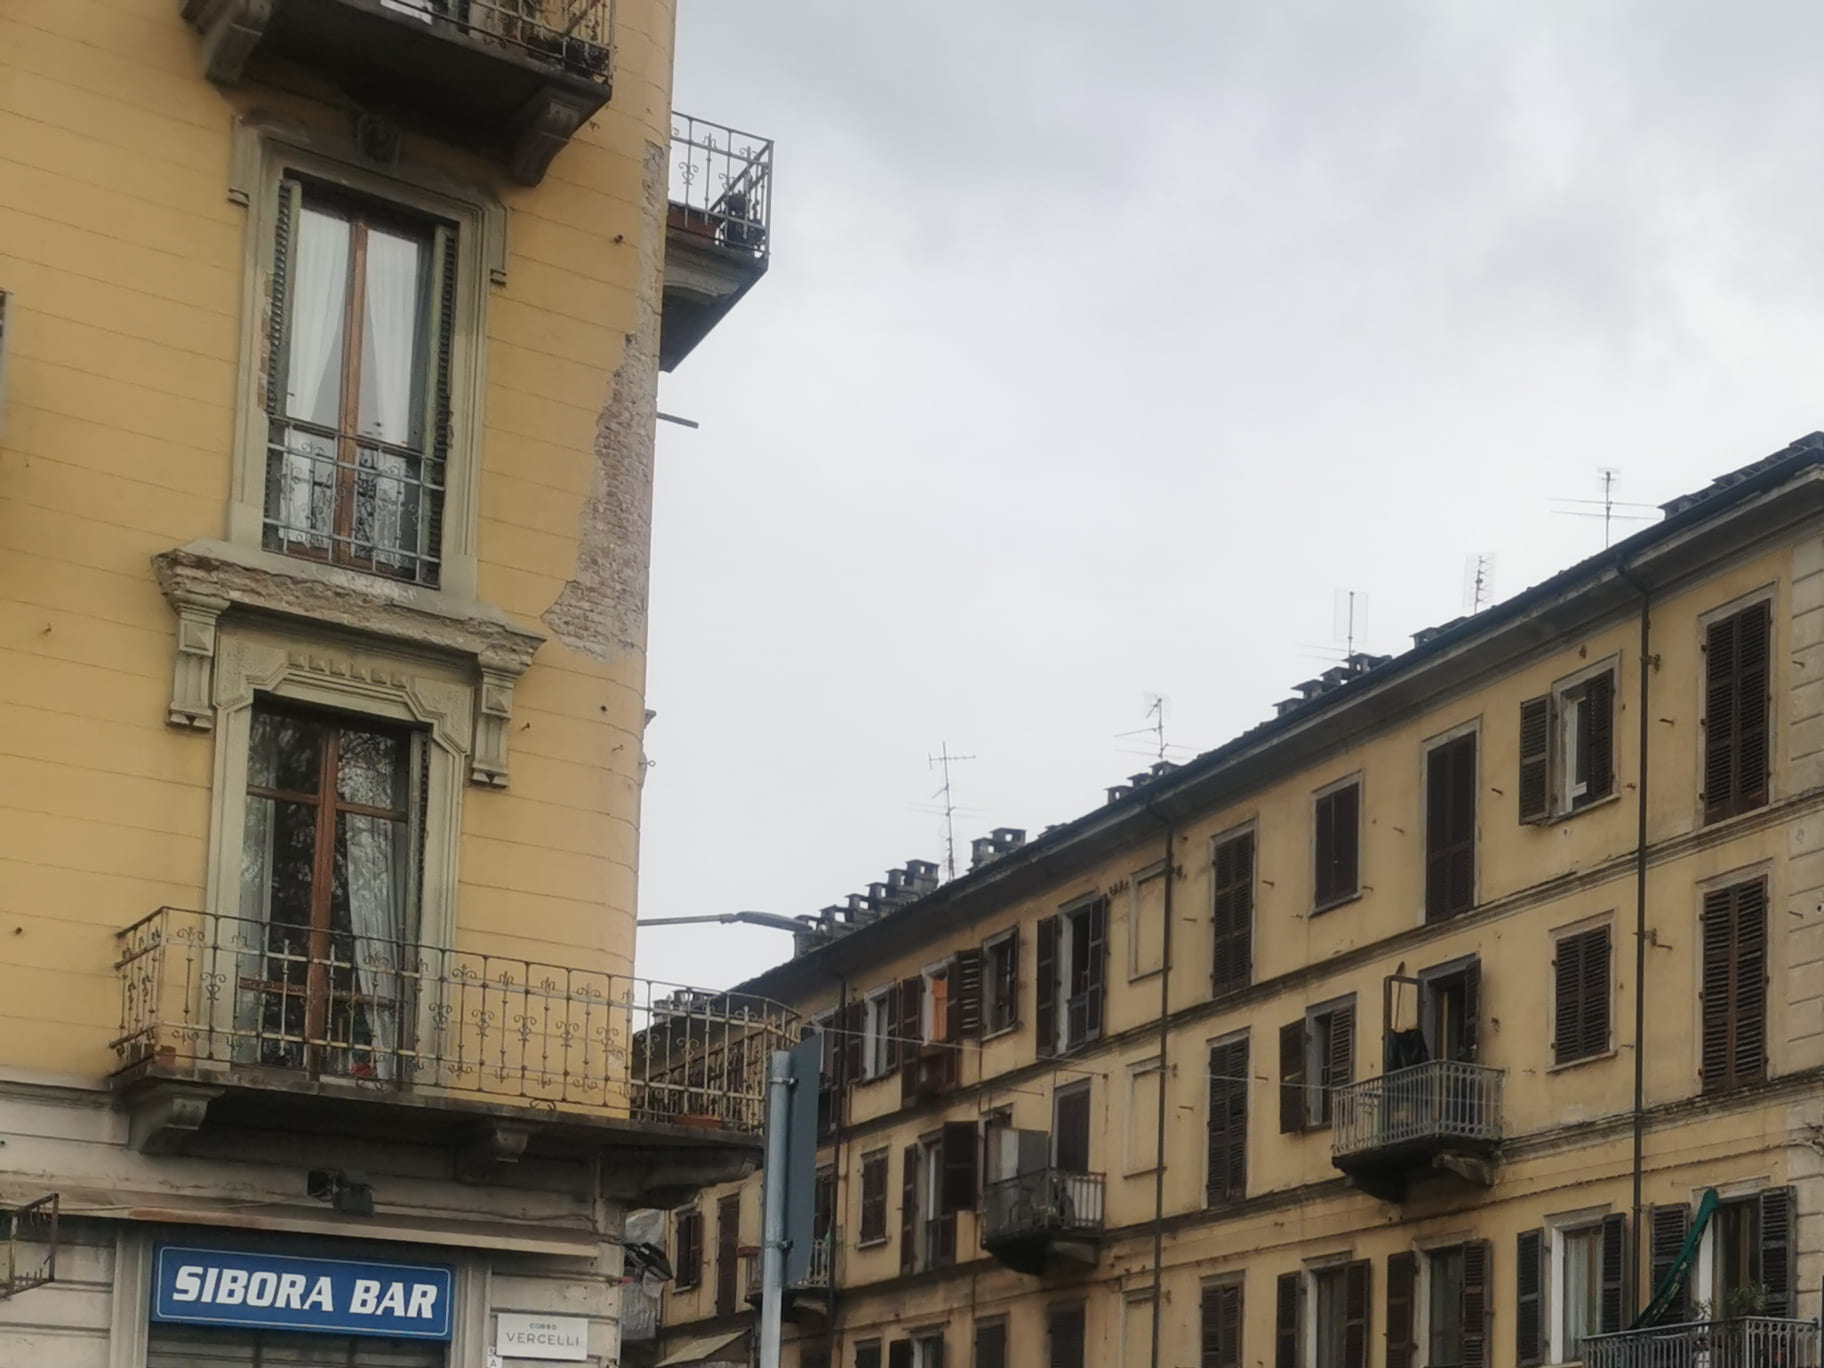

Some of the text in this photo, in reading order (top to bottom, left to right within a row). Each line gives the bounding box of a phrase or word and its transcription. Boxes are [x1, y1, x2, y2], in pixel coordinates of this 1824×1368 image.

[172, 1265, 437, 1319] SIBORA BAR
[506, 1332, 580, 1347] VERCELLI
